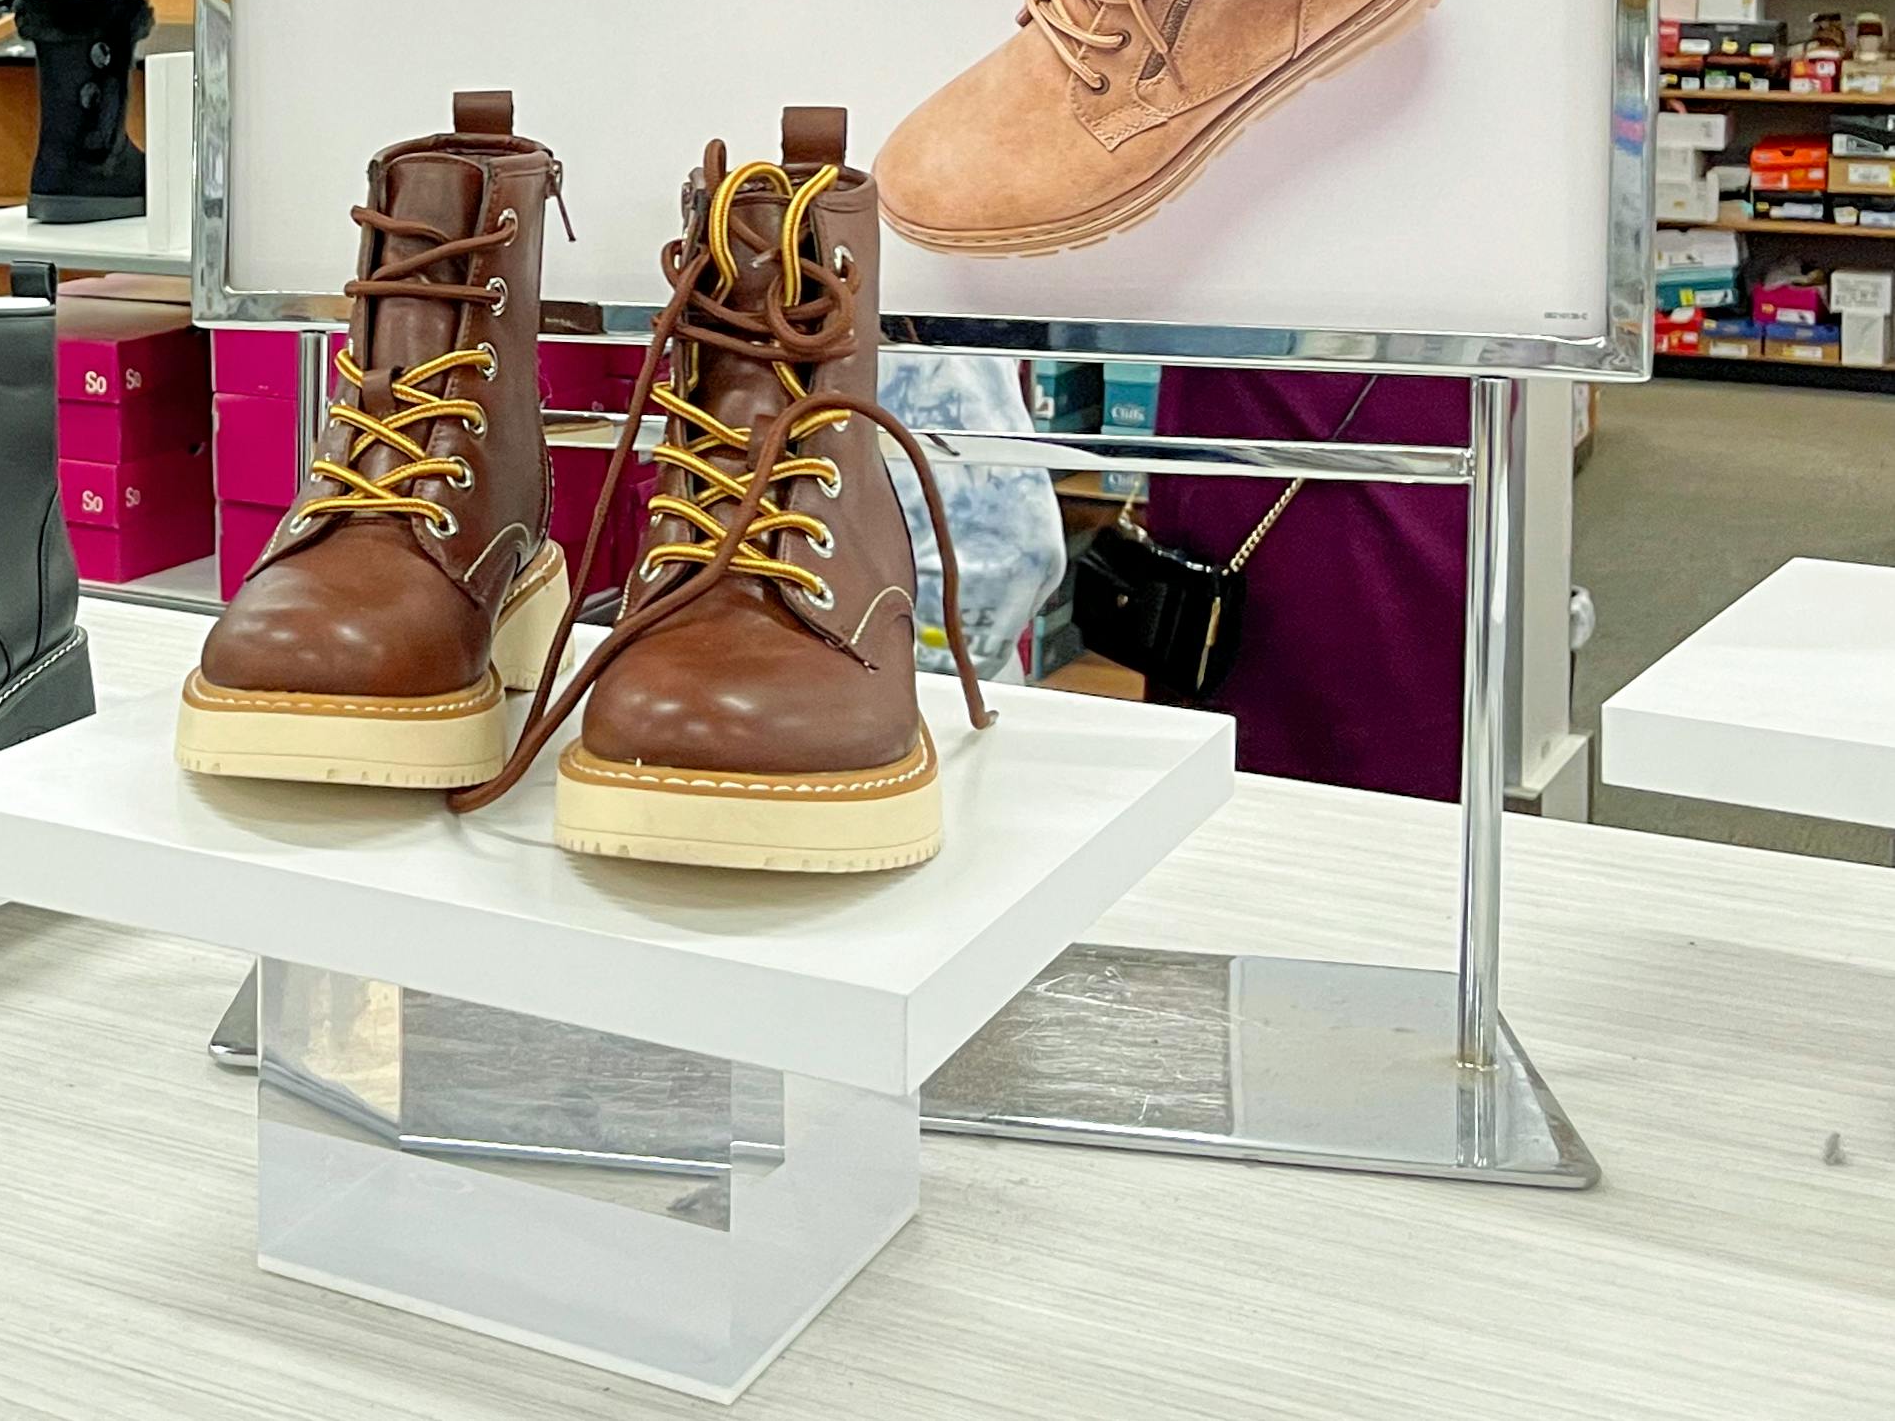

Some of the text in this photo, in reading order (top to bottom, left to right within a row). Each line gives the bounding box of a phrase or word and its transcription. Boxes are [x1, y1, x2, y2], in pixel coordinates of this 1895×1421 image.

[85, 371, 107, 395] So
[125, 368, 142, 390] So
[82, 490, 103, 513] So
[125, 486, 141, 508] So
